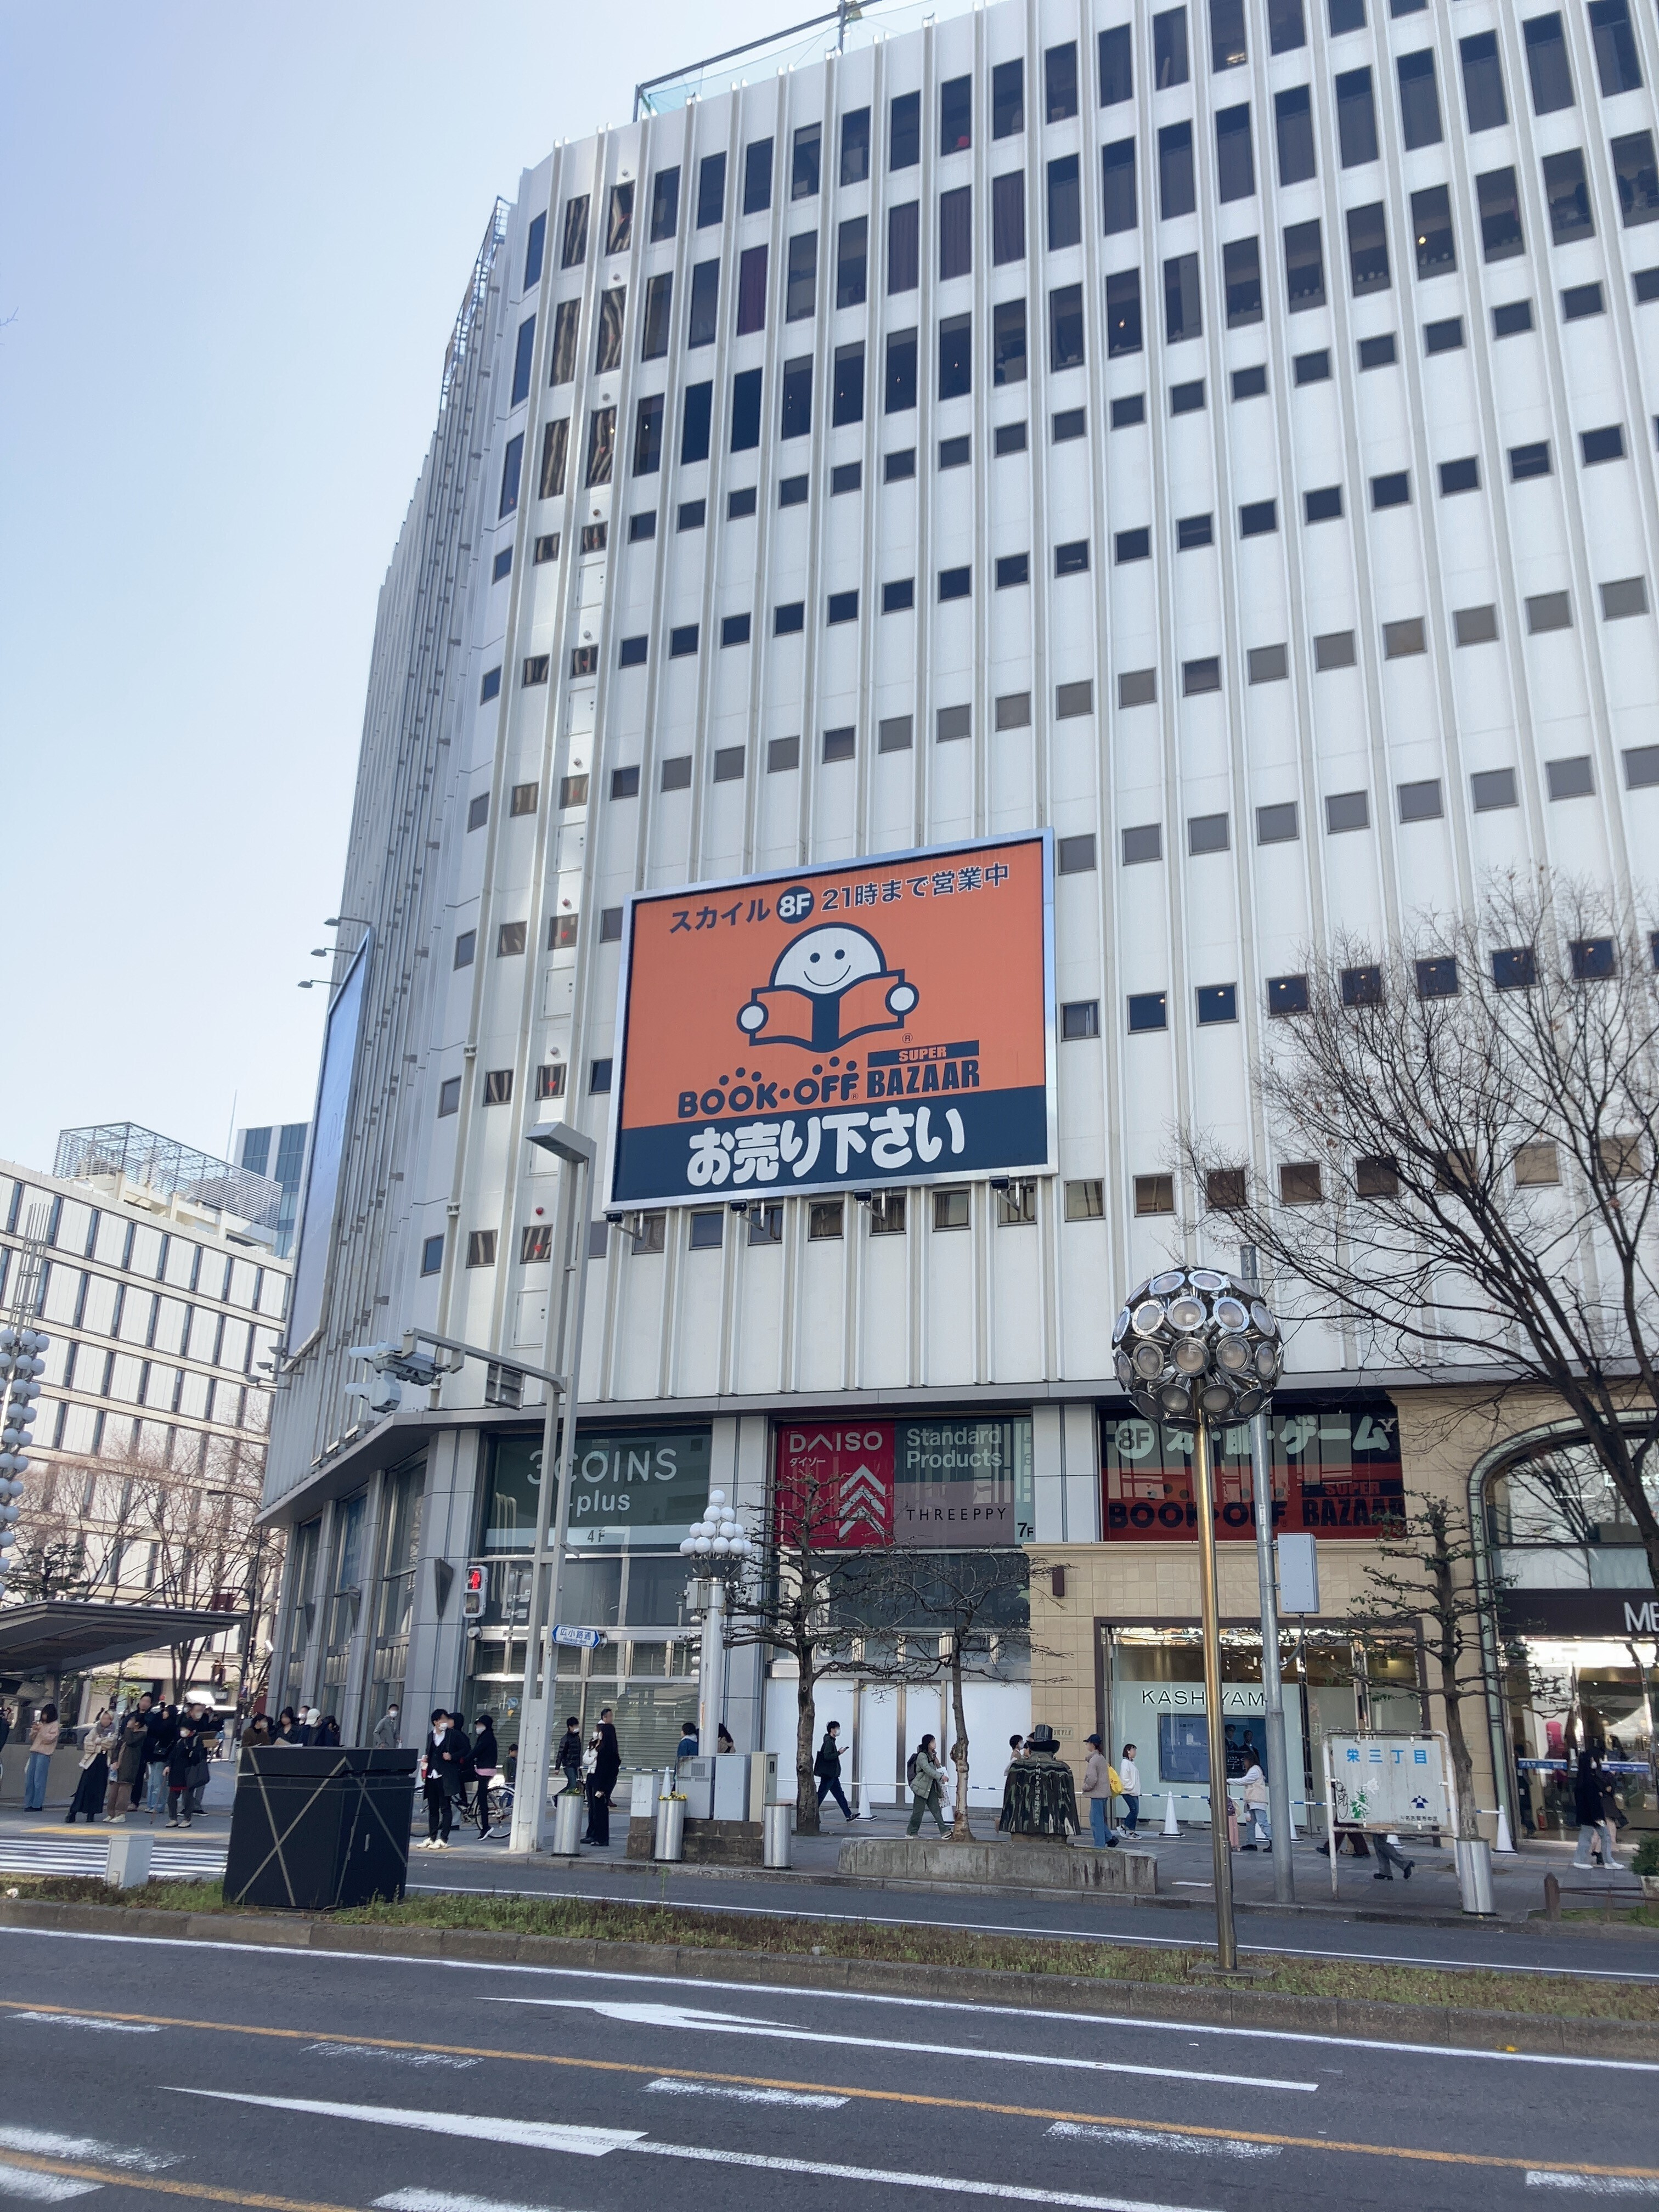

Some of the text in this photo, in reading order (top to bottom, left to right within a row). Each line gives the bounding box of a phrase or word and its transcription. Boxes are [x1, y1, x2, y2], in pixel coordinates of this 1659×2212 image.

[669, 862, 1009, 934] スカイル 8F 21時まで営業中
[898, 1045, 947, 1062] SUPER
[867, 1059, 980, 1099] BAZAAR
[686, 1105, 965, 1187] お売り下さい
[789, 1431, 883, 1453] DAISO
[906, 1426, 1002, 1447] Standard
[1119, 1427, 1150, 1450] 8F
[789, 1457, 826, 1468] ダイソー
[906, 1448, 1003, 1469] Products
[1324, 1481, 1380, 1496] SUPER
[568, 1489, 631, 1518] plus
[906, 1508, 1007, 1521] THREEPPY
[1017, 1522, 1034, 1537] 7F
[560, 1628, 591, 1640] 広小路通
[1142, 1690, 1265, 1707] KASHYAM
[1346, 1748, 1427, 1764] 栄三丁目
